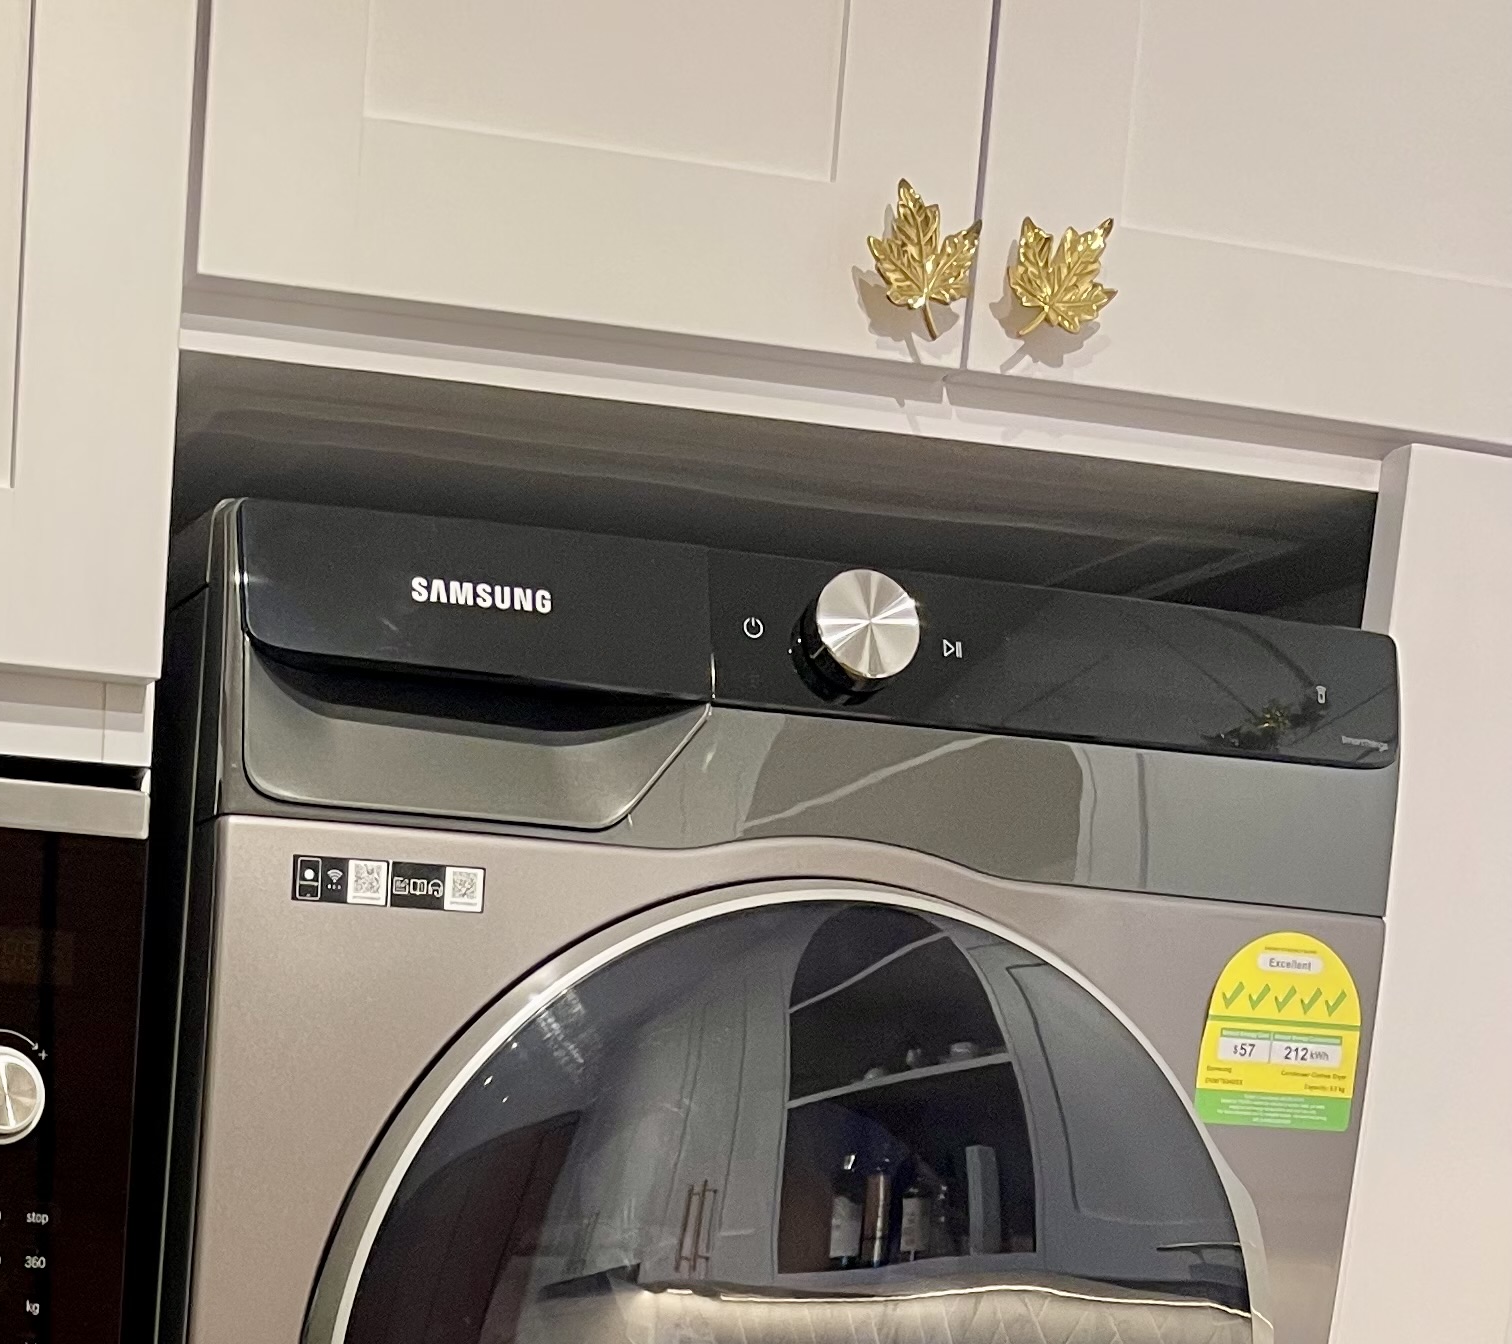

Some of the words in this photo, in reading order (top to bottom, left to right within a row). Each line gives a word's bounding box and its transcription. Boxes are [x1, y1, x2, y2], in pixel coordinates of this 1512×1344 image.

[411, 576, 553, 615] SAMSUNG
[1268, 957, 1313, 972] Excellent
[1232, 1042, 1257, 1058] $57
[26, 1211, 49, 1226] stop
[24, 1255, 46, 1270] 360
[25, 1299, 40, 1316] kg
